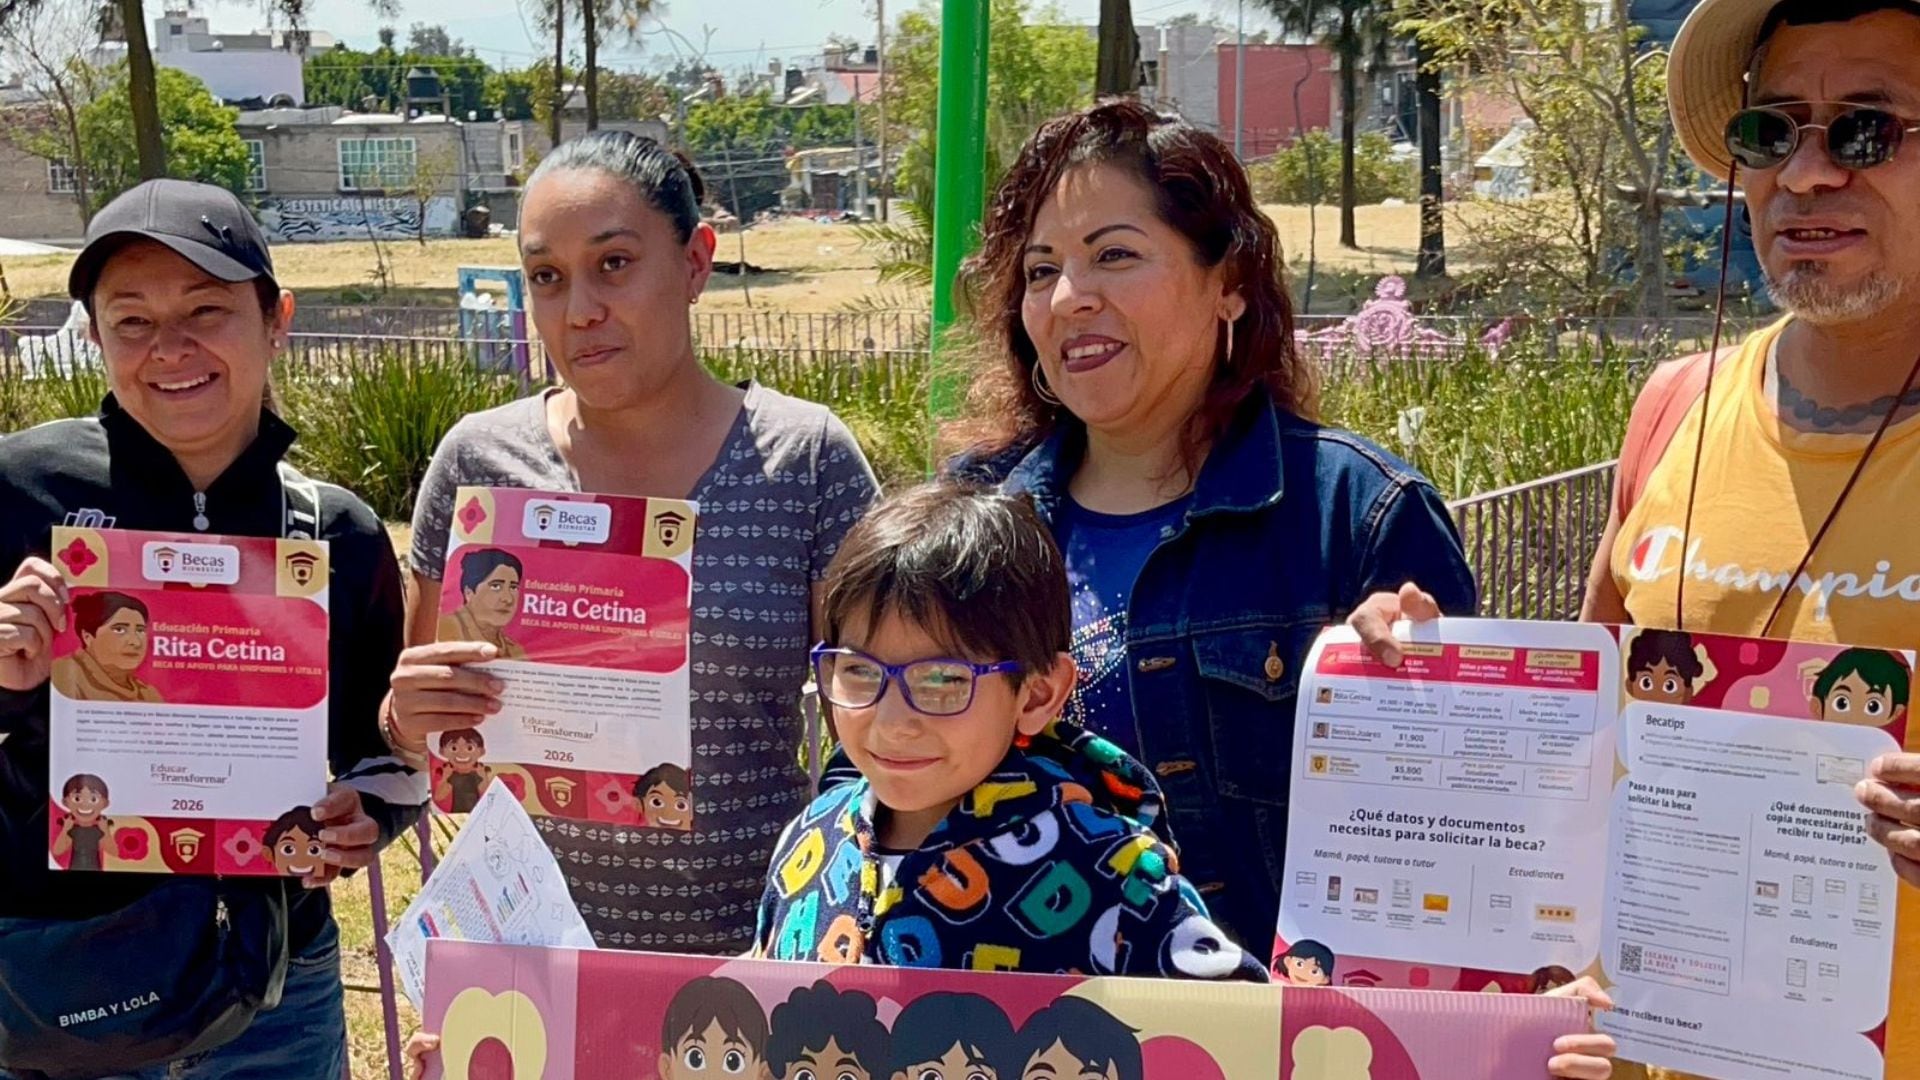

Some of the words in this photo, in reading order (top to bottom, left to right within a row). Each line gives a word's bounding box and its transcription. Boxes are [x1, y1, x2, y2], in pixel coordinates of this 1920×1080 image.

[558, 511, 597, 526] Becas
[182, 553, 225, 567] Becas
[524, 579, 576, 593] Educación
[578, 584, 625, 598] Primaria
[522, 594, 568, 616] Rita
[572, 598, 647, 625] Cetina
[153, 621, 209, 634] Educación
[212, 624, 261, 637] Primaria
[552, 621, 579, 631] APOYO
[153, 636, 202, 658] Rita
[207, 638, 285, 662] Cetina
[1646, 714, 1685, 730] Becatips
[532, 725, 594, 739] Transformar
[544, 749, 574, 762] 2026
[150, 763, 188, 773] Educar
[161, 773, 227, 784] Transformar
[1628, 781, 1647, 792] Paso
[1655, 787, 1675, 797] paso
[1677, 789, 1697, 800] para
[172, 799, 204, 811] 2026
[1628, 793, 1660, 806] solicitar
[1661, 798, 1670, 807] la
[1671, 800, 1692, 811] beca
[1770, 800, 1796, 812] ¿Qué
[1798, 804, 1862, 820] documentos
[1349, 808, 1383, 822] ¿Qué
[1386, 811, 1424, 825] datos
[1427, 817, 1436, 828] y
[1439, 816, 1526, 834] documentos
[1766, 813, 1793, 824] copia
[1795, 817, 1854, 831] necesitarás
[1329, 822, 1392, 838] necesitas
[1395, 830, 1426, 841] para
[1429, 831, 1485, 846] solicitar
[1489, 835, 1501, 848] la
[1505, 837, 1546, 852] beca?
[1777, 826, 1810, 838] recibir
[1812, 831, 1824, 840] tu
[1826, 832, 1868, 845] tarjeta?
[1345, 853, 1370, 864] papá,
[1373, 855, 1402, 865] tutora
[1412, 859, 1437, 868] tutor
[1855, 862, 1878, 872] tutor
[1508, 866, 1565, 880] Estudiantes
[1789, 934, 1838, 950] Estudiantes
[59, 1006, 108, 1028] BIMBA
[109, 1003, 119, 1015] Y
[122, 991, 161, 1012] LOLA
[1631, 1010, 1663, 1023] recibes
[1664, 1016, 1675, 1026] tu
[1676, 1017, 1703, 1031] beca?
